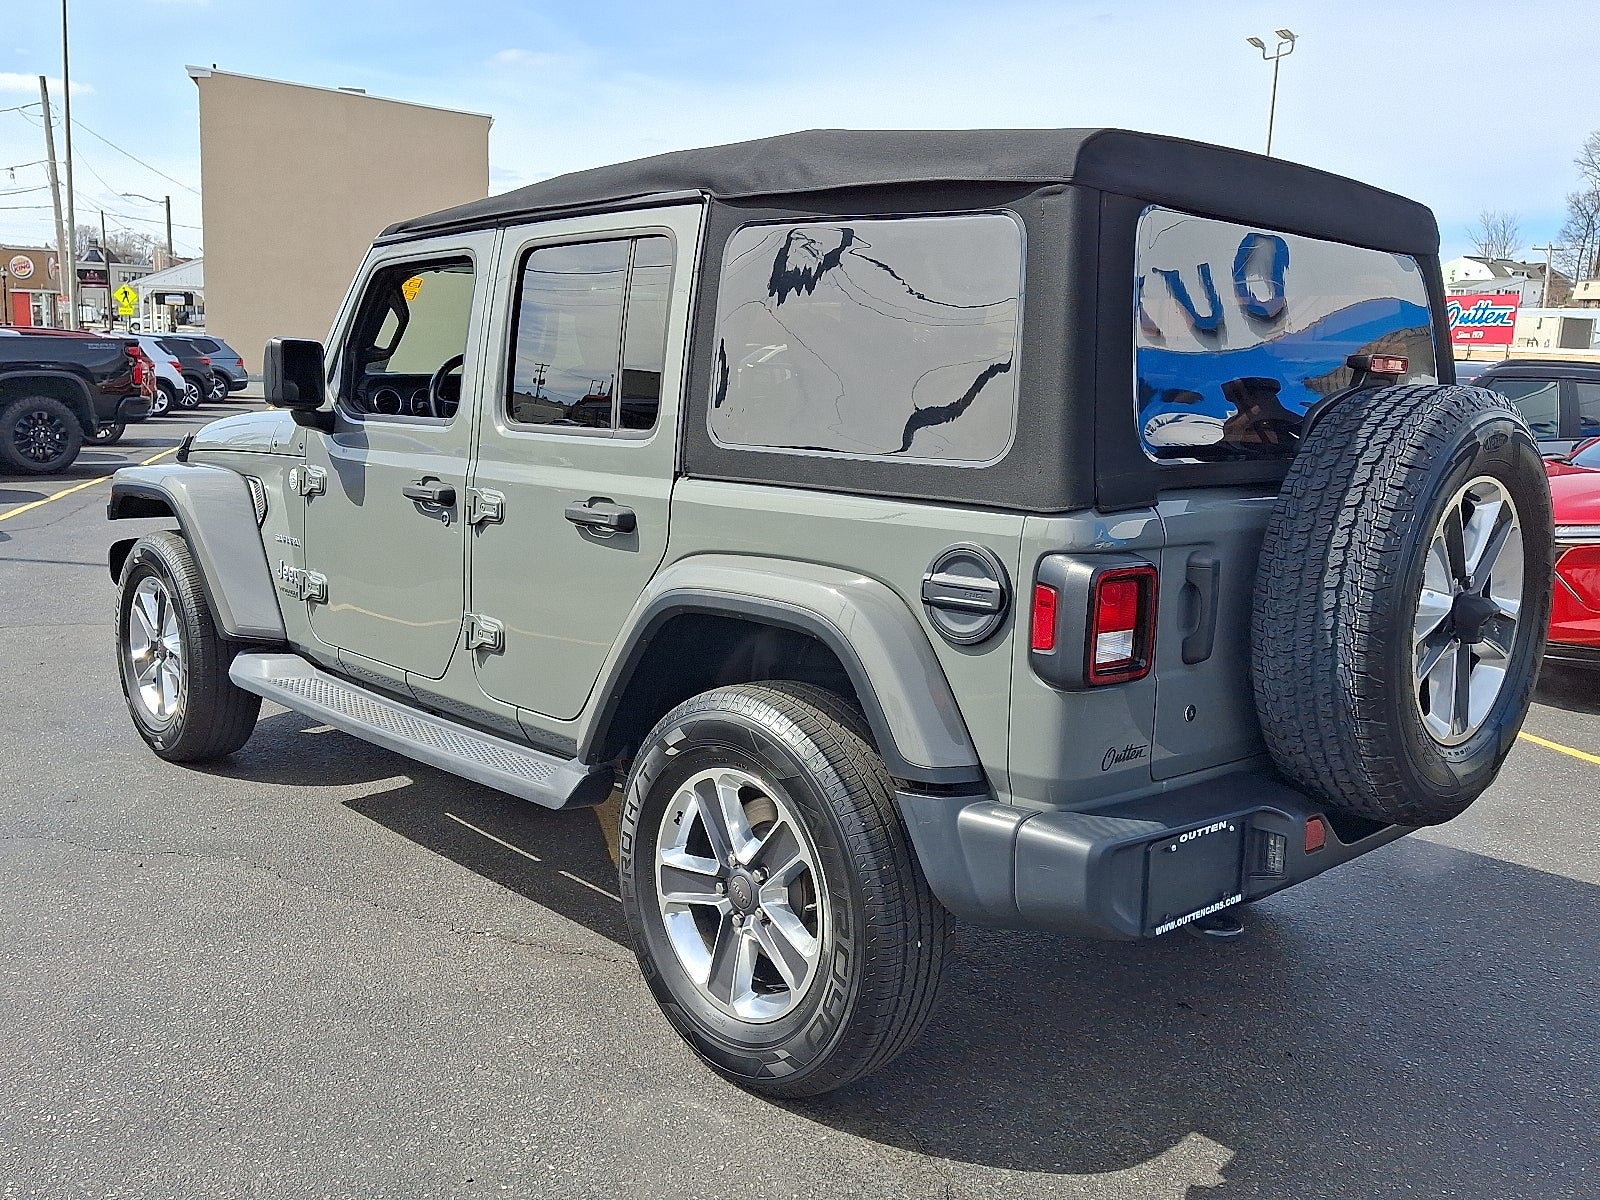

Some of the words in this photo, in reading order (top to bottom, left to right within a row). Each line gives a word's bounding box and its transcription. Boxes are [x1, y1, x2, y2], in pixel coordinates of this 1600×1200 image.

[14, 263, 31, 272] KING
[1447, 301, 1514, 328] Outten
[1102, 743, 1148, 771] Outten
[625, 762, 651, 826] H/T
[1180, 821, 1228, 843] OUTTEN
[1155, 894, 1242, 935] WWW.OUTTENCARS.COM
